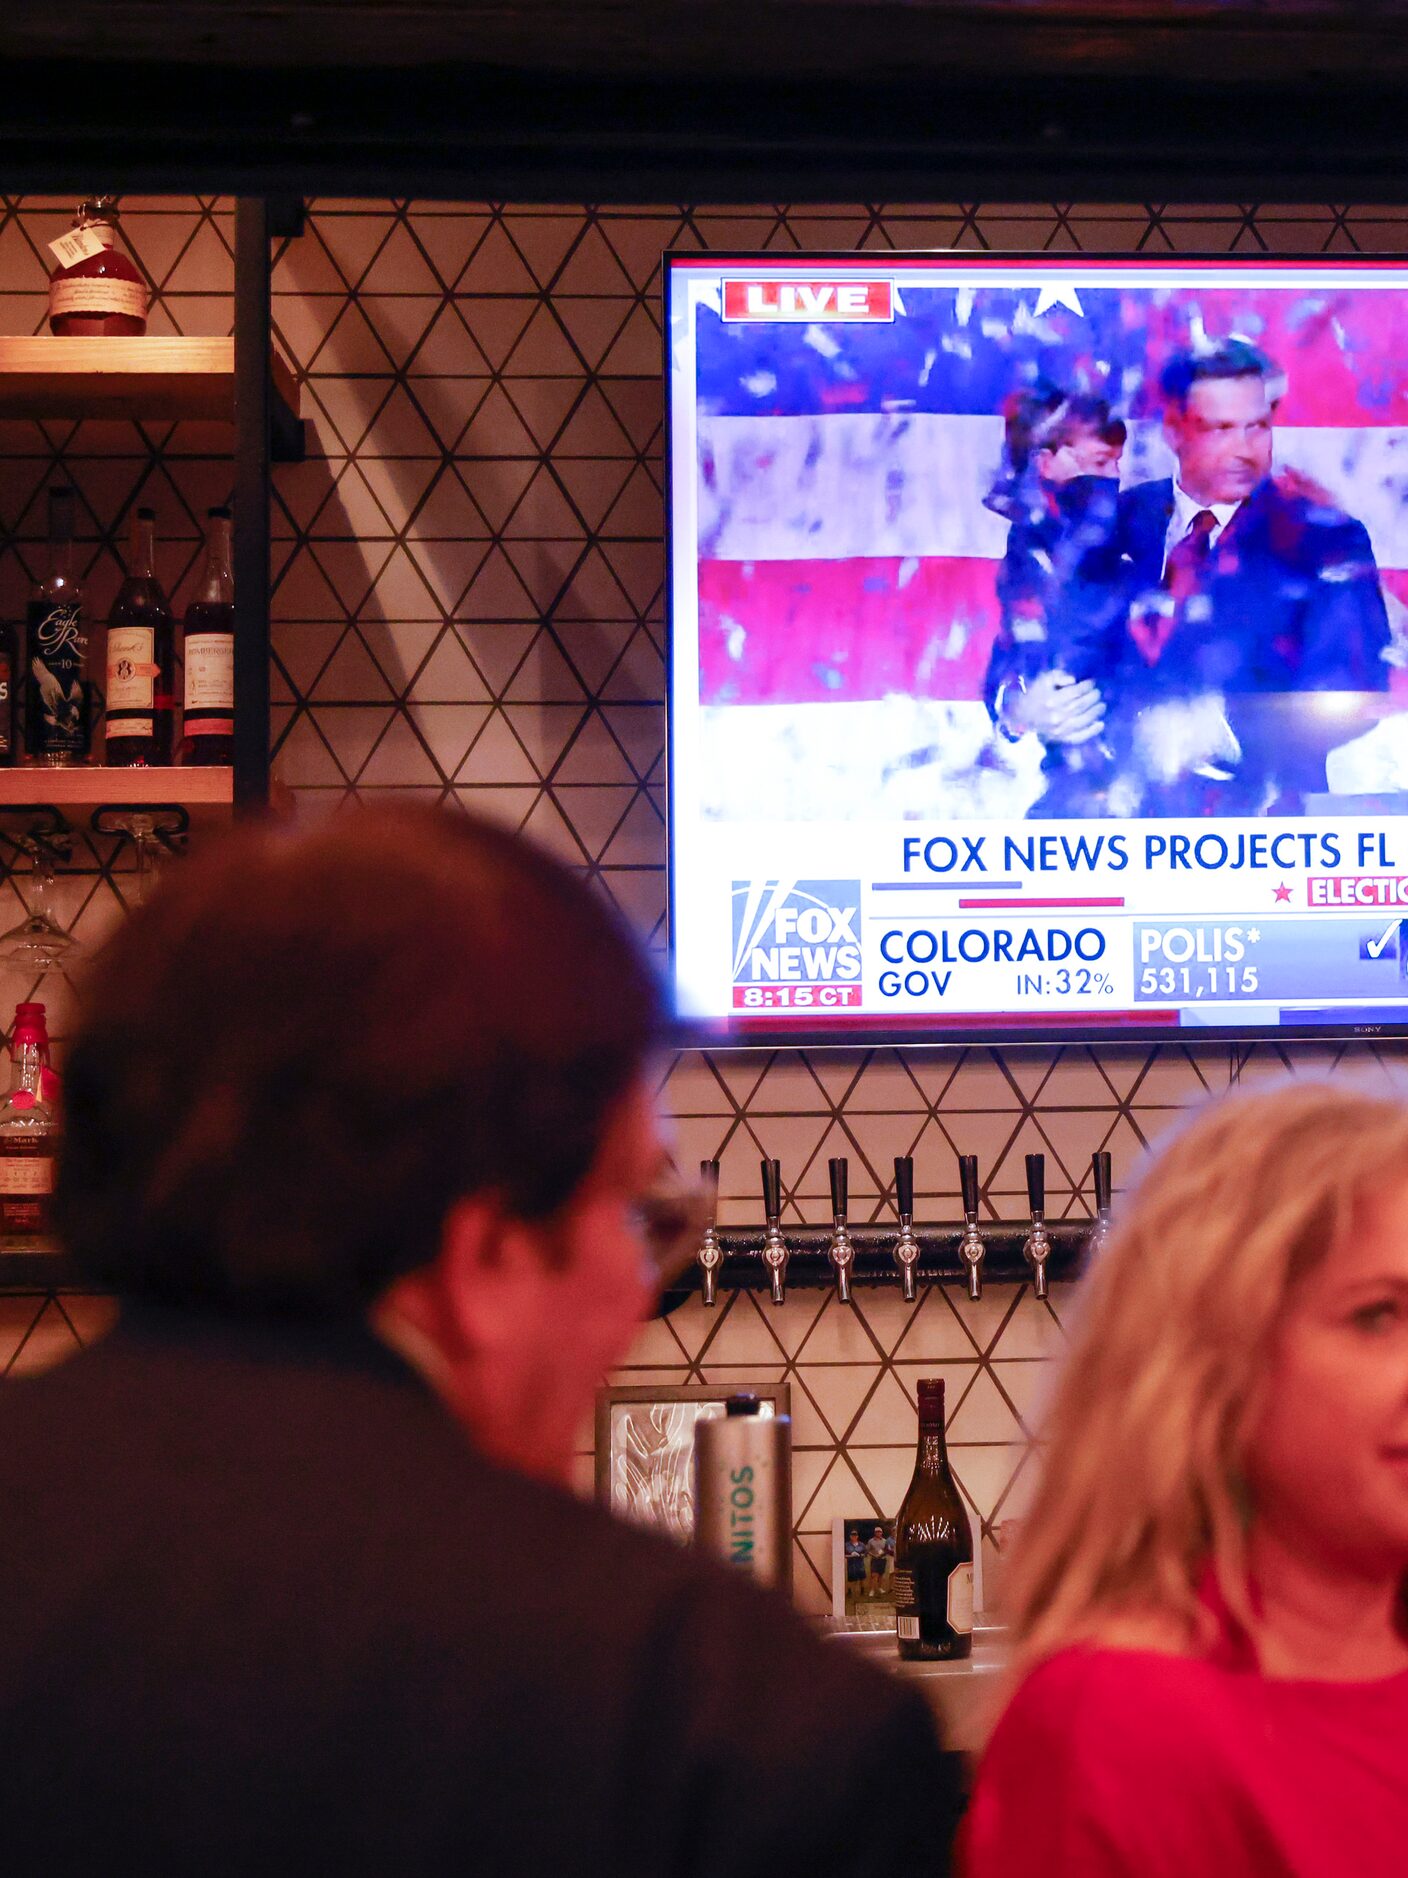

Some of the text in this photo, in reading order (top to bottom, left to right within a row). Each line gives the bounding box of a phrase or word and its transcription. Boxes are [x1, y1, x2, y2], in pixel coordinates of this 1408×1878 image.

[747, 285, 870, 314] LIVE
[38, 607, 82, 646] Eagle
[44, 627, 88, 660] Rare
[903, 837, 987, 873] FOX
[1005, 835, 1129, 872] NEWS
[1145, 832, 1342, 871] PROJECTS
[1358, 831, 1396, 867] FL
[775, 907, 858, 944] FOX
[879, 926, 1107, 964] COLORADO
[751, 946, 862, 981] NEWS
[743, 987, 853, 1007] 8:15 CT
[878, 971, 952, 997] GOV
[1140, 965, 1259, 999] 531,115
